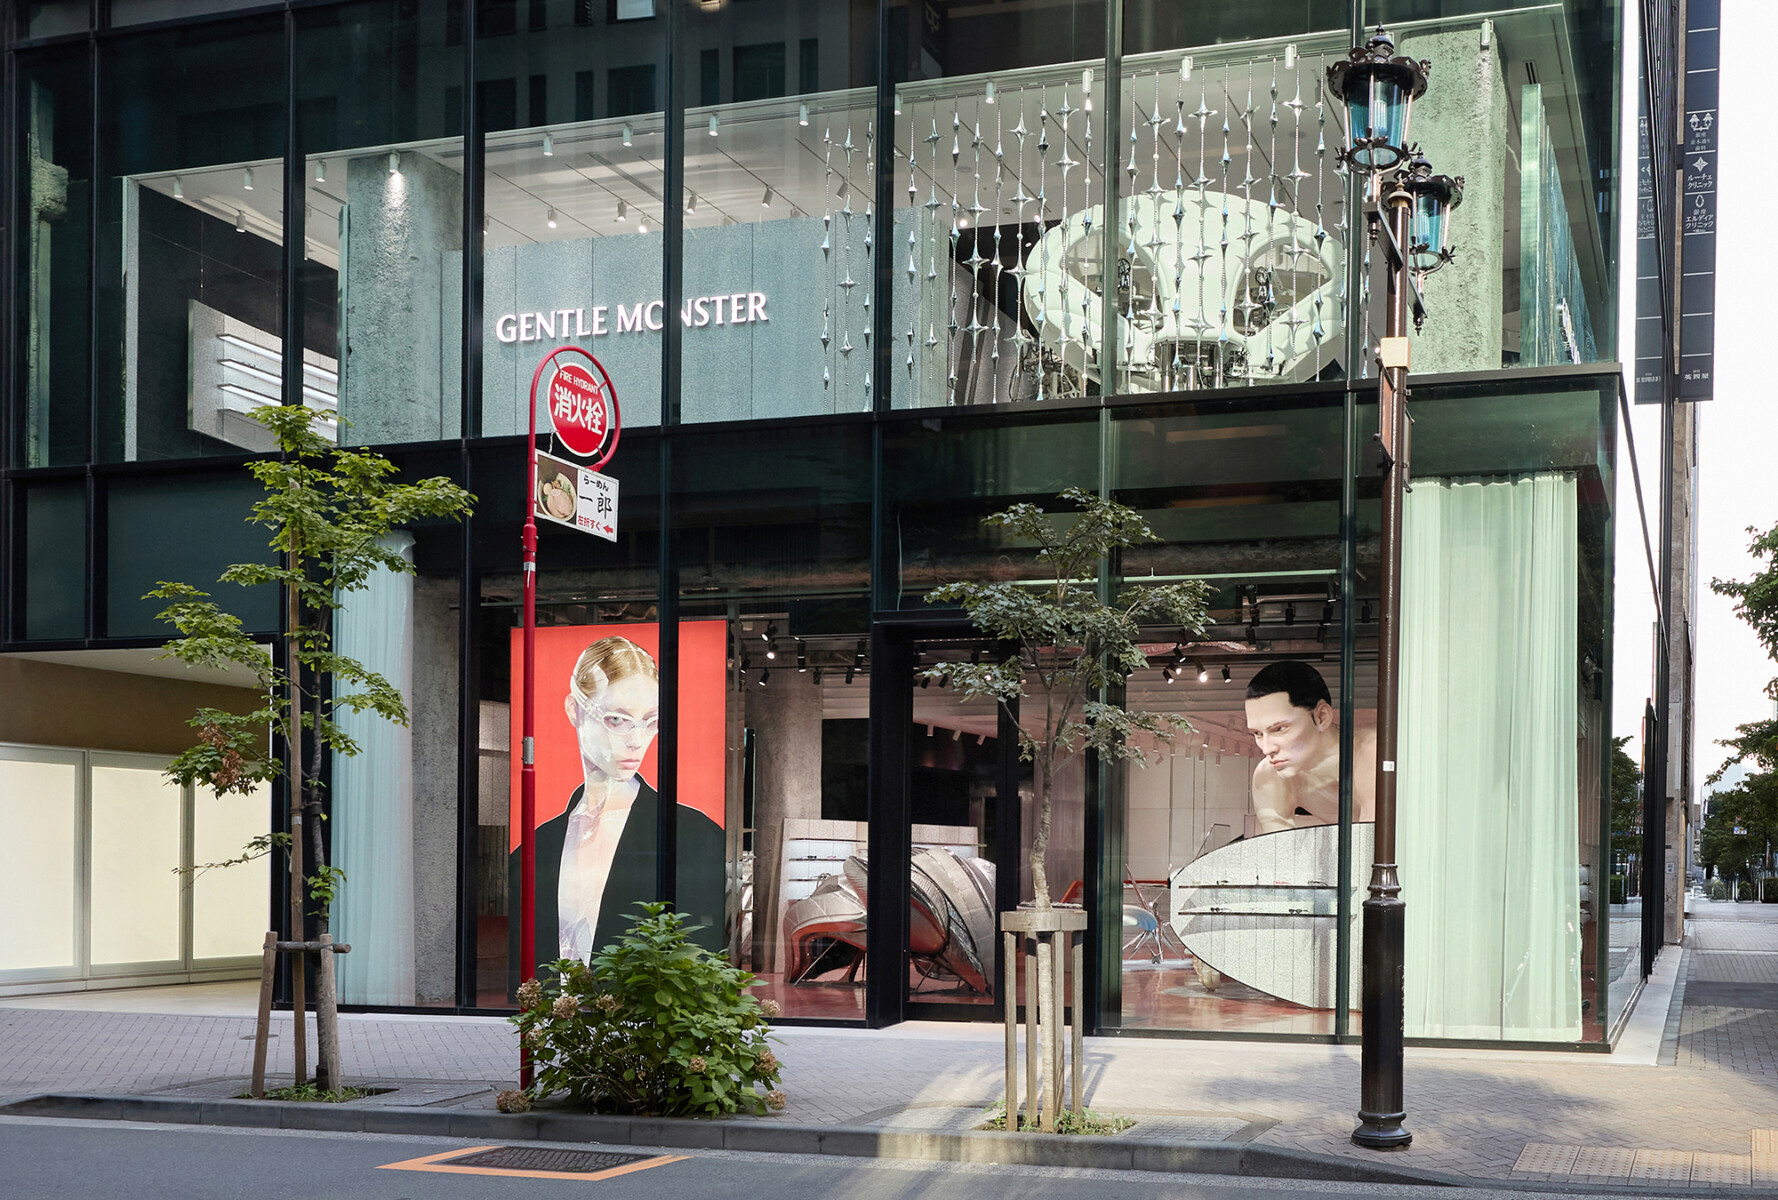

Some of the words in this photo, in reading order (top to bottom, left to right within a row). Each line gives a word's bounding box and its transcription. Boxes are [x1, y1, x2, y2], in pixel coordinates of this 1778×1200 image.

[1687, 173, 1713, 181] ルーチェ
[1687, 180, 1713, 189] クリニック
[1685, 221, 1714, 230] クリニック
[495, 306, 609, 343] GENTLE
[559, 369, 573, 384] FIRE
[573, 375, 599, 395] HYDRANT
[554, 383, 604, 435] 消火栓
[583, 474, 610, 492] らーめん
[579, 492, 613, 520] 一郎
